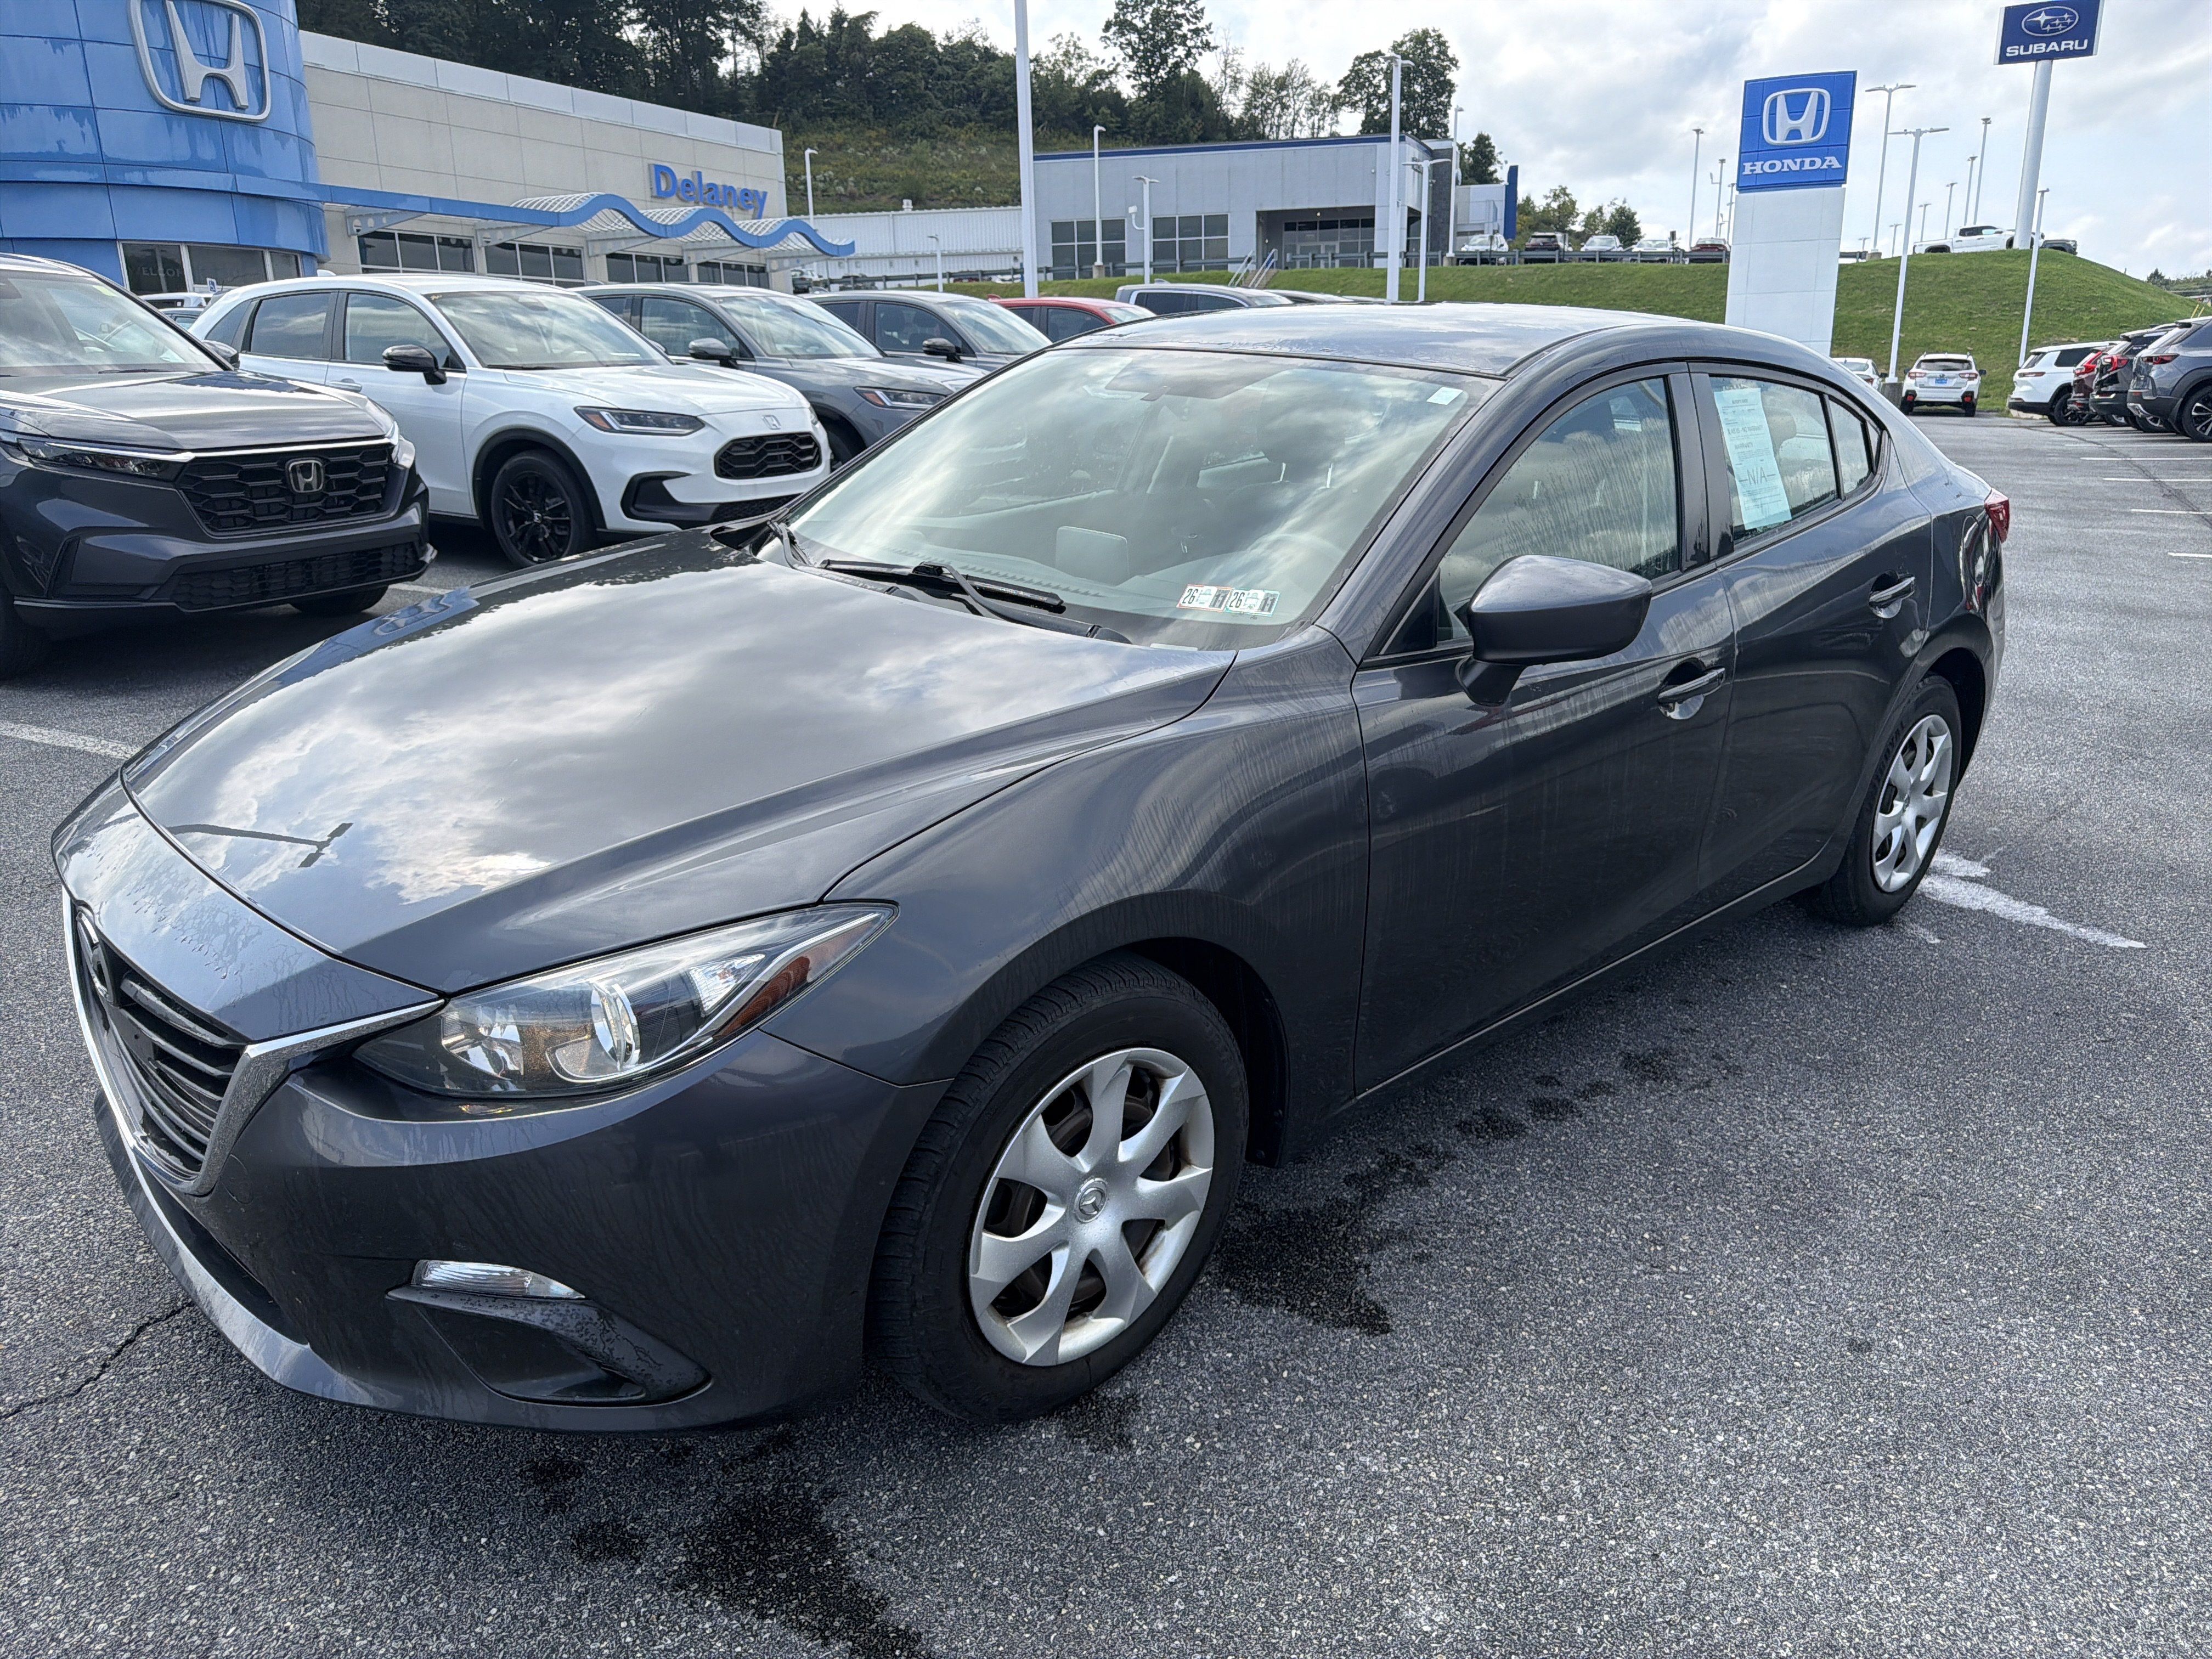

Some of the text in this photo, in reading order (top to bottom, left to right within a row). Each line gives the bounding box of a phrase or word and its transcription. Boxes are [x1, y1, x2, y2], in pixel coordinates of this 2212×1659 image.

[2005, 38, 2089, 57] SUBARU
[1742, 156, 1843, 175] HONDA
[652, 164, 768, 220] Delaney
[1182, 588, 1199, 605] 26
[1229, 591, 1245, 608] 26
